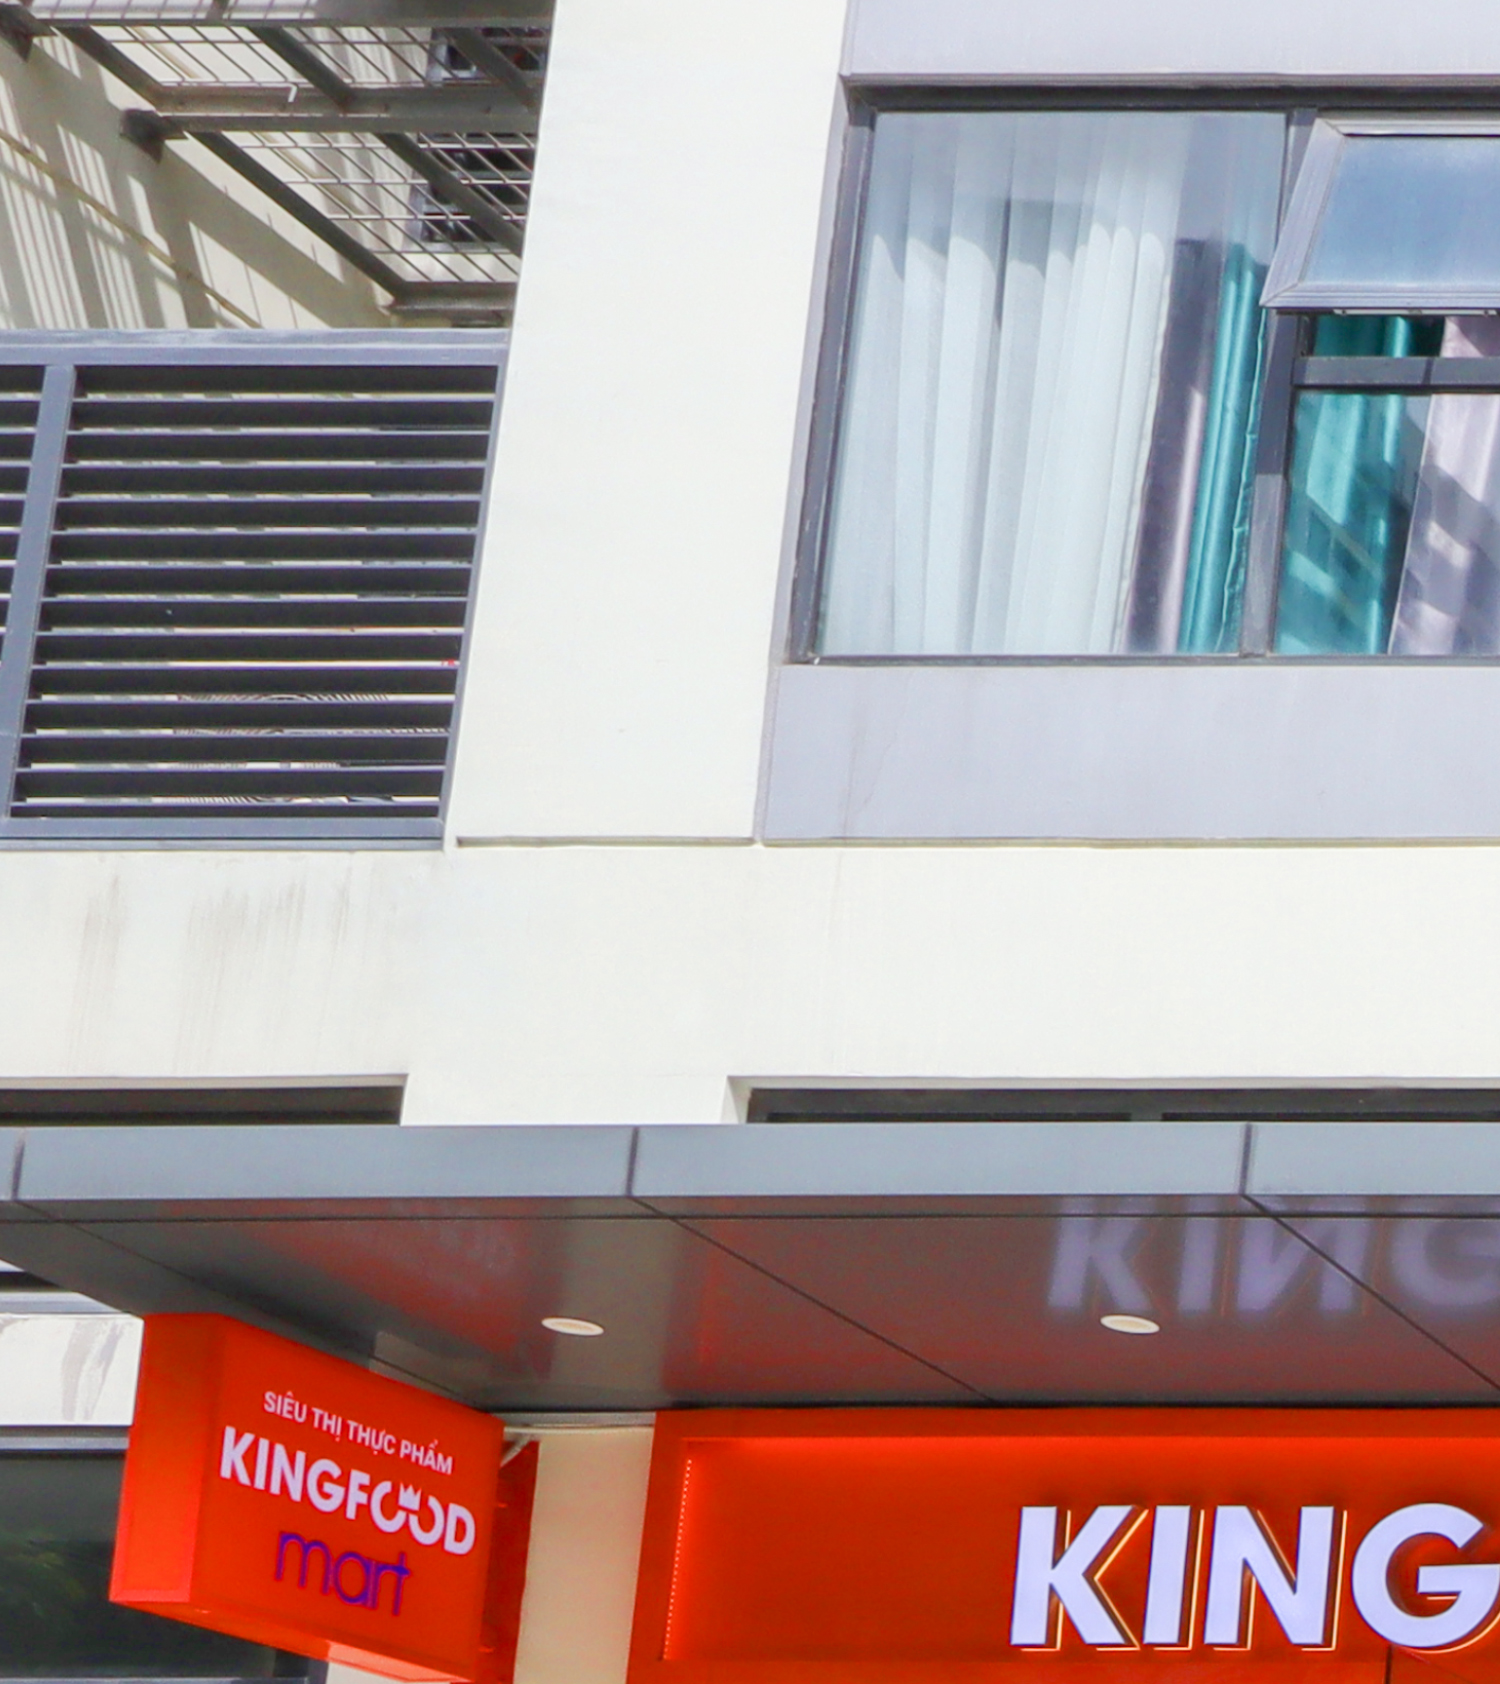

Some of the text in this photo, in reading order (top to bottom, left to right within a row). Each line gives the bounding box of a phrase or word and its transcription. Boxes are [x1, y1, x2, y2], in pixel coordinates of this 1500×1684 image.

[263, 1391, 454, 1476] SIÊU THỊ THỰC PHẨM
[219, 1426, 477, 1556] KINGFOOD
[273, 1531, 411, 1616] mart
